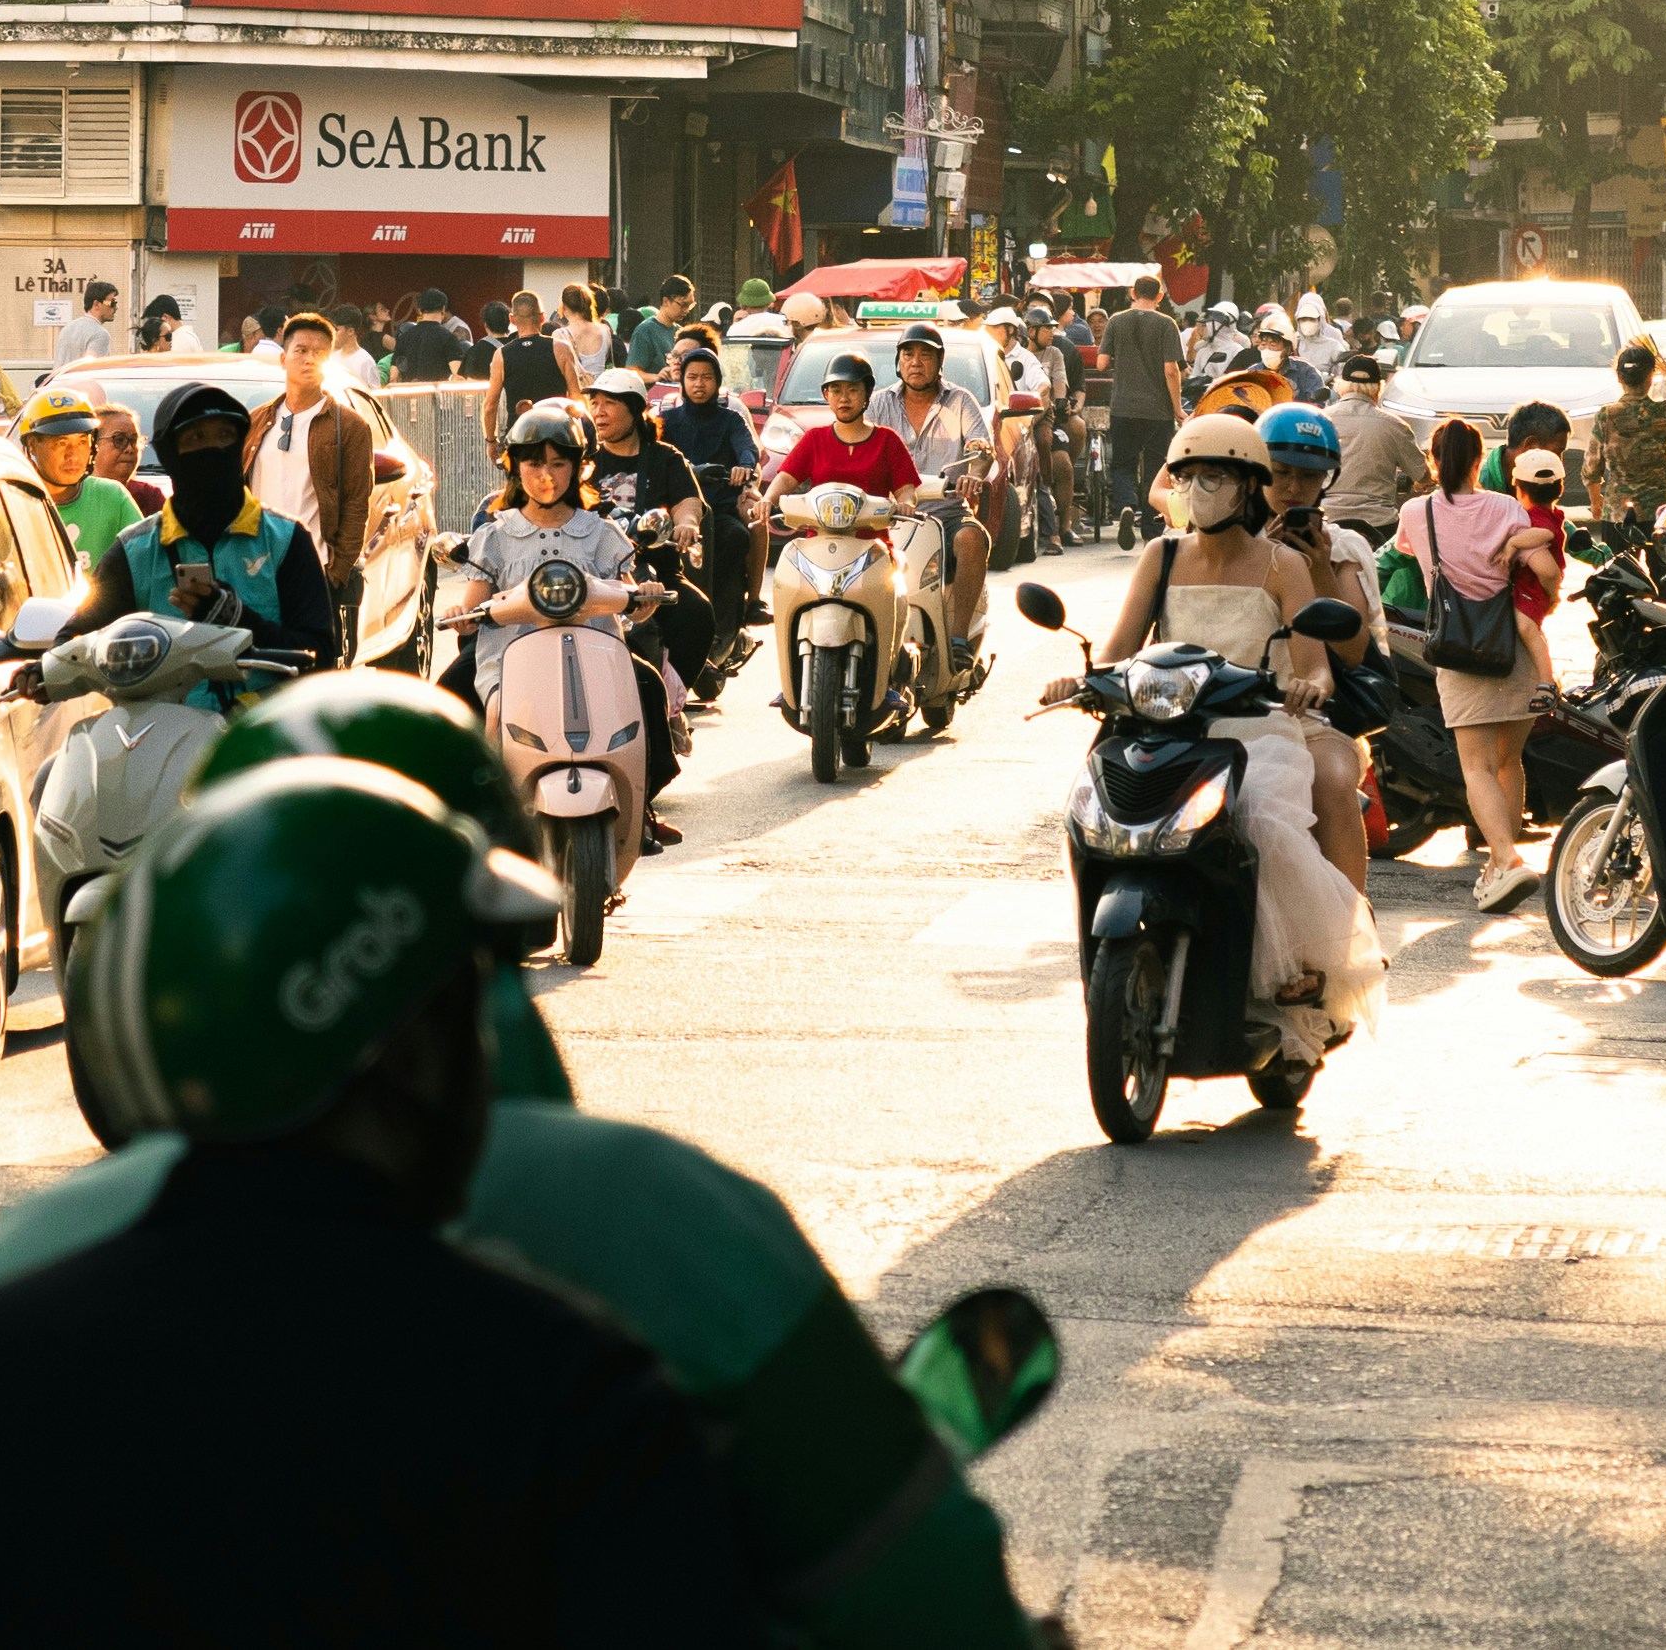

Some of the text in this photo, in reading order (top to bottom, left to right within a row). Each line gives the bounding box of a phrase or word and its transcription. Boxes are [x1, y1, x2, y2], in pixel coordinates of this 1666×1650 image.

[316, 112, 547, 175] SeABank
[239, 222, 276, 240] ATM
[372, 224, 408, 242] ATM
[501, 226, 537, 245] ATM
[43, 258, 67, 274] 3A
[15, 276, 73, 293] Lê Thái
[277, 884, 424, 1032] Grab
